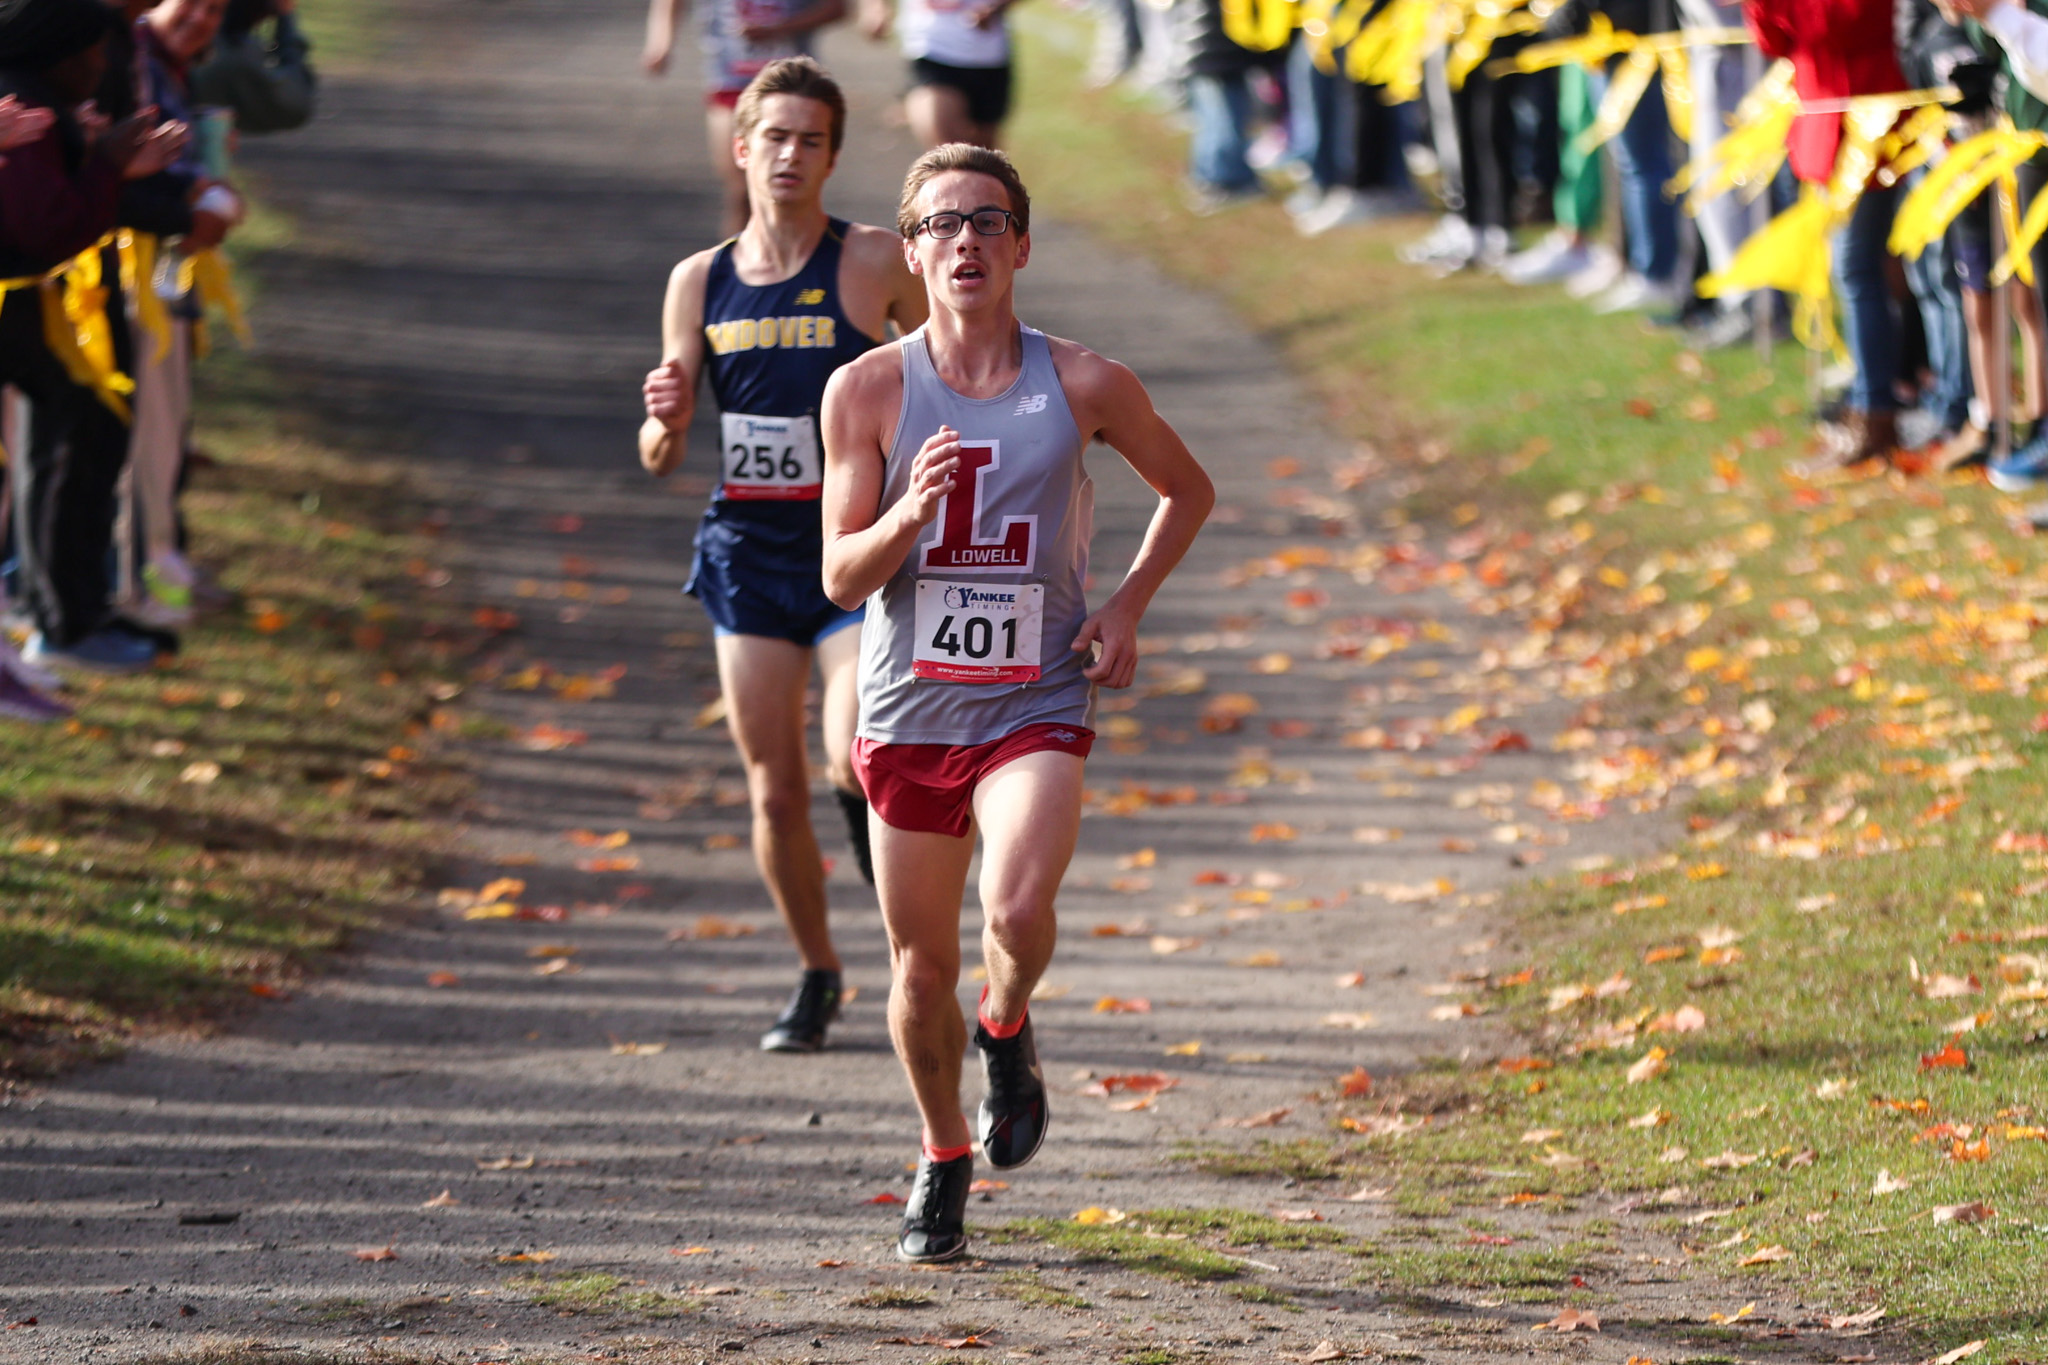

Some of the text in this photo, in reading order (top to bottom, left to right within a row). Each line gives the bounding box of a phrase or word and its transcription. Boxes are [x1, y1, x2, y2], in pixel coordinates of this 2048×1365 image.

[731, 444, 802, 479] 256
[918, 439, 1039, 574] L
[951, 549, 1020, 564] LOWELL
[958, 587, 1015, 608] YANKEE
[971, 603, 1010, 611] TIMING
[931, 615, 1017, 659] 401
